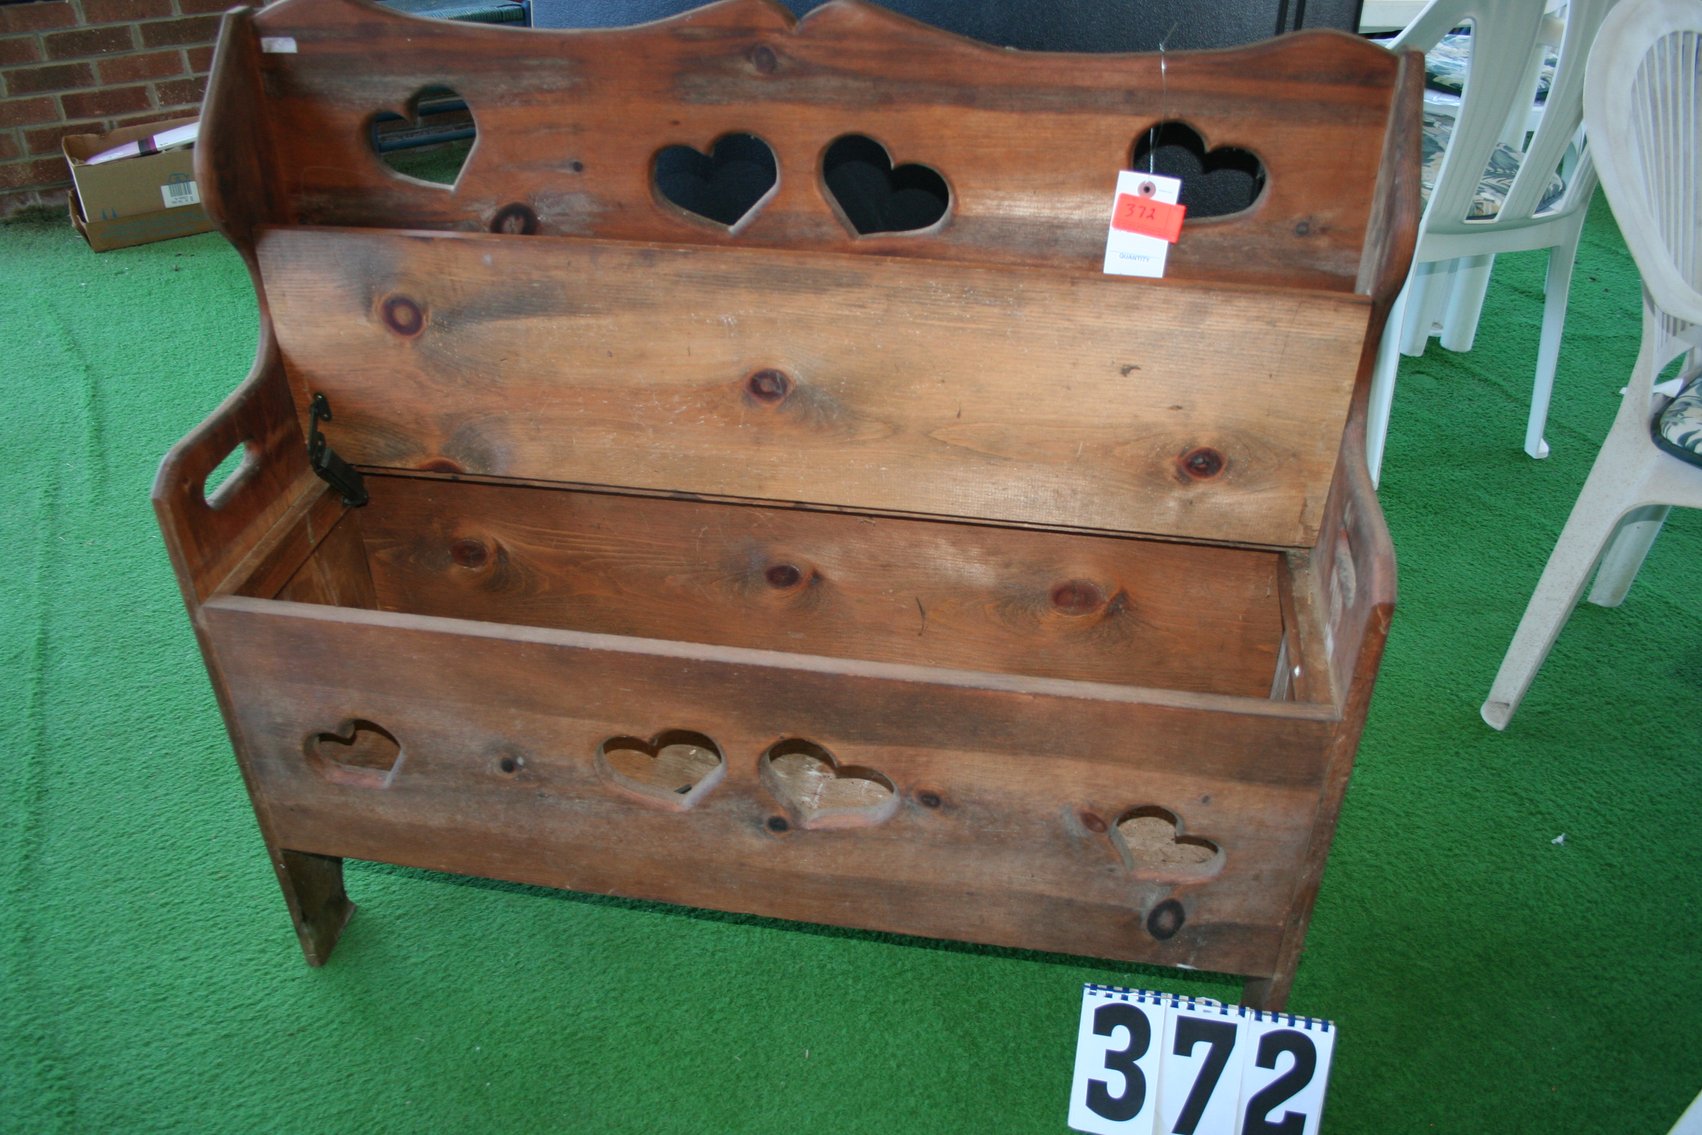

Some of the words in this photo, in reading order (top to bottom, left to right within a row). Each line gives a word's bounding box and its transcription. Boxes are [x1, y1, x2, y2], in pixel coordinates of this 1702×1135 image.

[1125, 203, 1155, 220] 372
[1119, 252, 1150, 263] QUANTITY
[1085, 1002, 1317, 1135] 372
